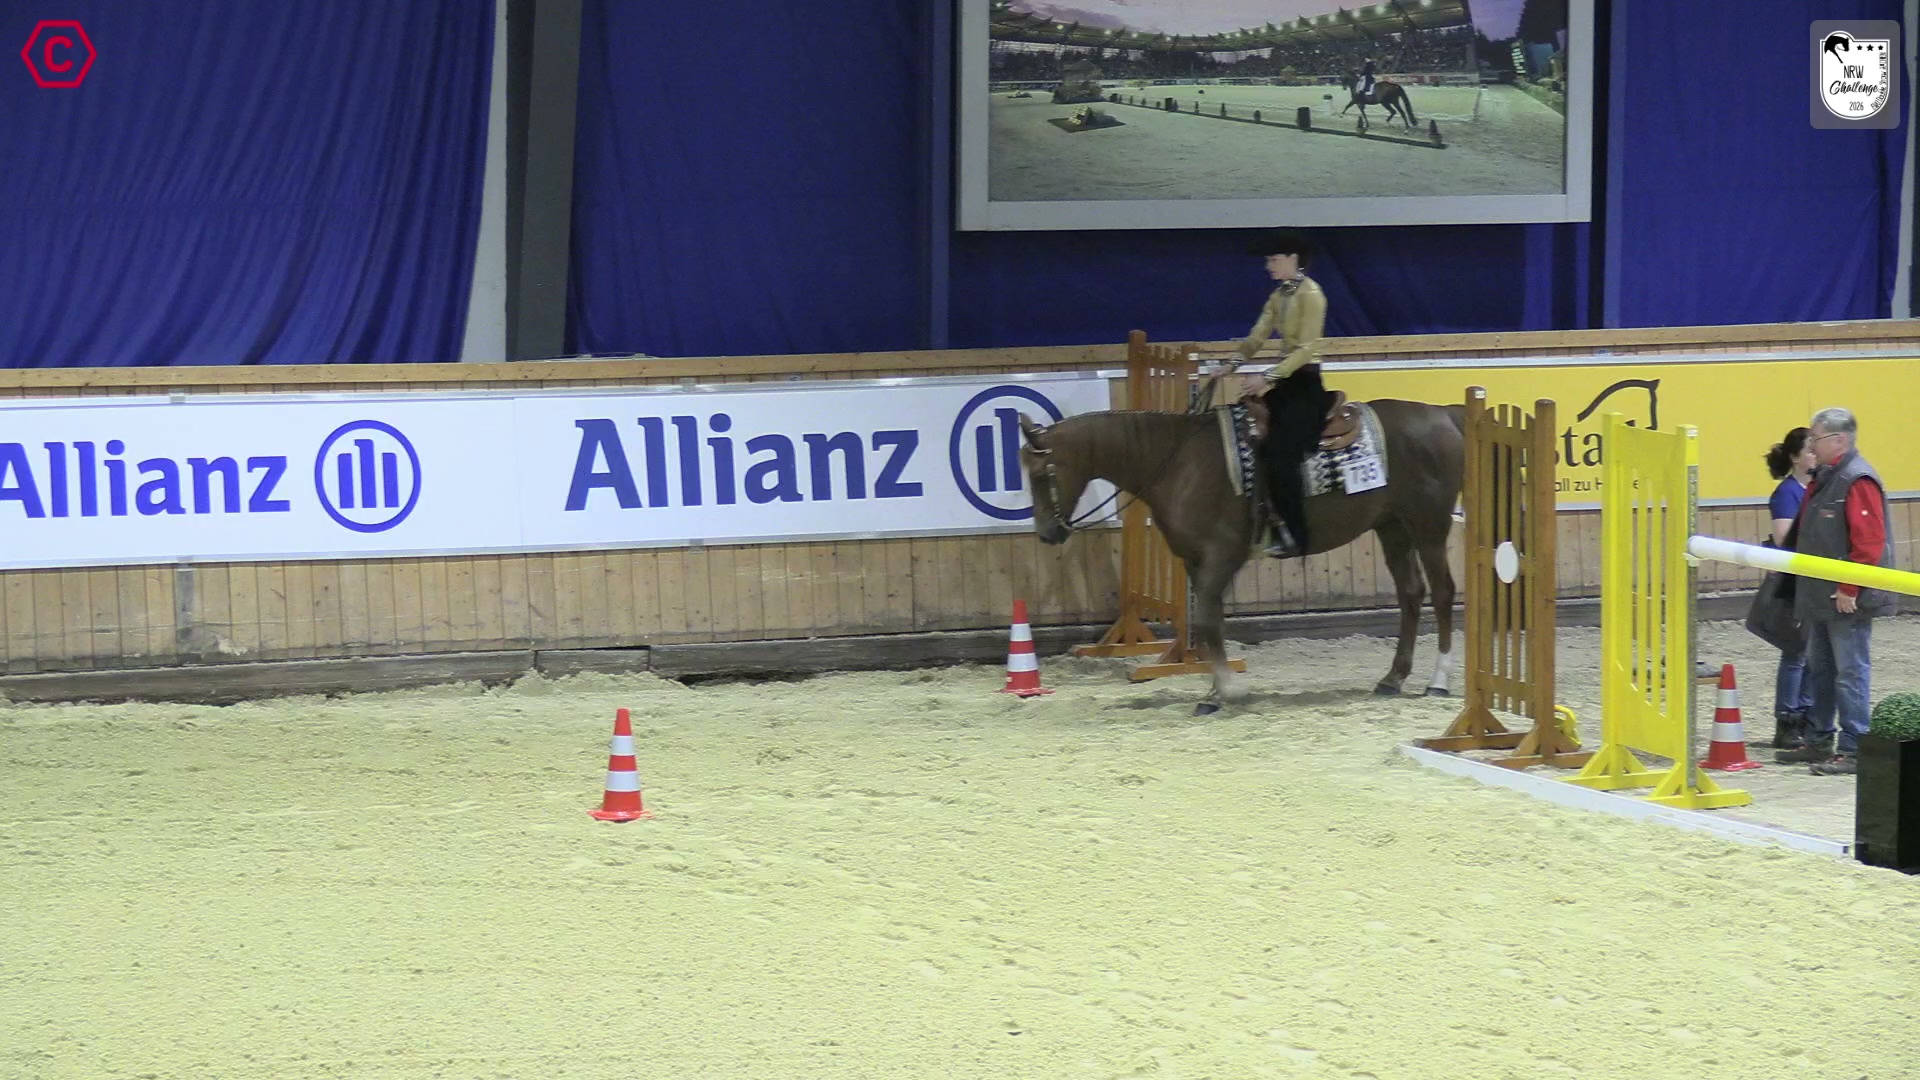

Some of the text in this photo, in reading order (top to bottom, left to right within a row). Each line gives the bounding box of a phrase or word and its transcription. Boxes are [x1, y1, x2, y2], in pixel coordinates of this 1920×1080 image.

[0, 439, 291, 518] Allianz
[564, 412, 923, 511] Allianz
[1574, 480, 1591, 492] zu
